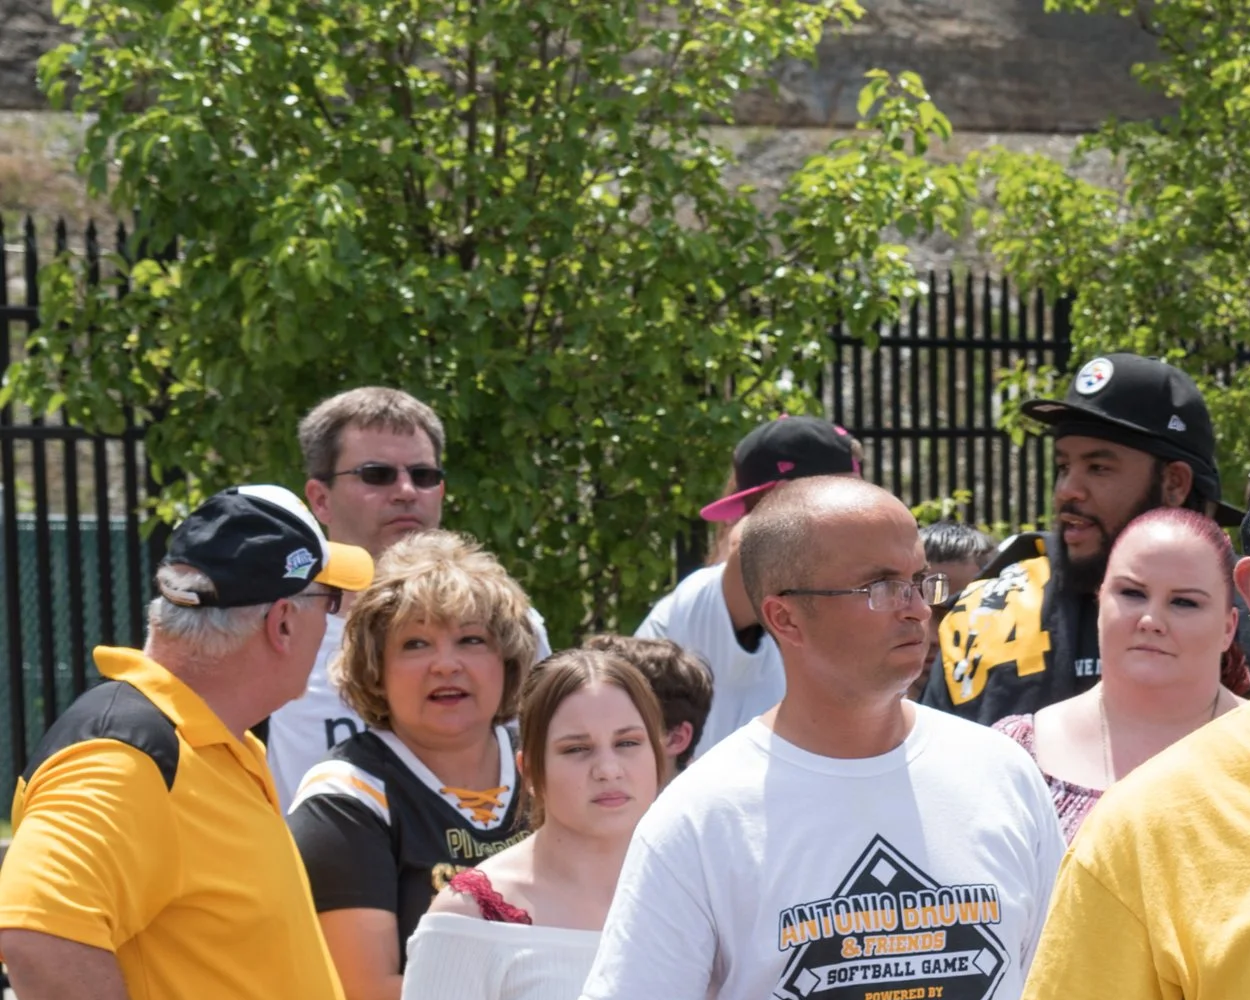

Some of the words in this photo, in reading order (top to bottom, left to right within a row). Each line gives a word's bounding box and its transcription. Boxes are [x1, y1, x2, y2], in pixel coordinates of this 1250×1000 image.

[779, 892, 899, 951] ANTONIO
[899, 884, 1001, 930] BROWN
[841, 936, 861, 958] &
[863, 930, 946, 956] FRIENDS
[827, 960, 915, 985] SOFTBALL
[921, 956, 969, 975] GAME
[928, 986, 943, 998] BY
